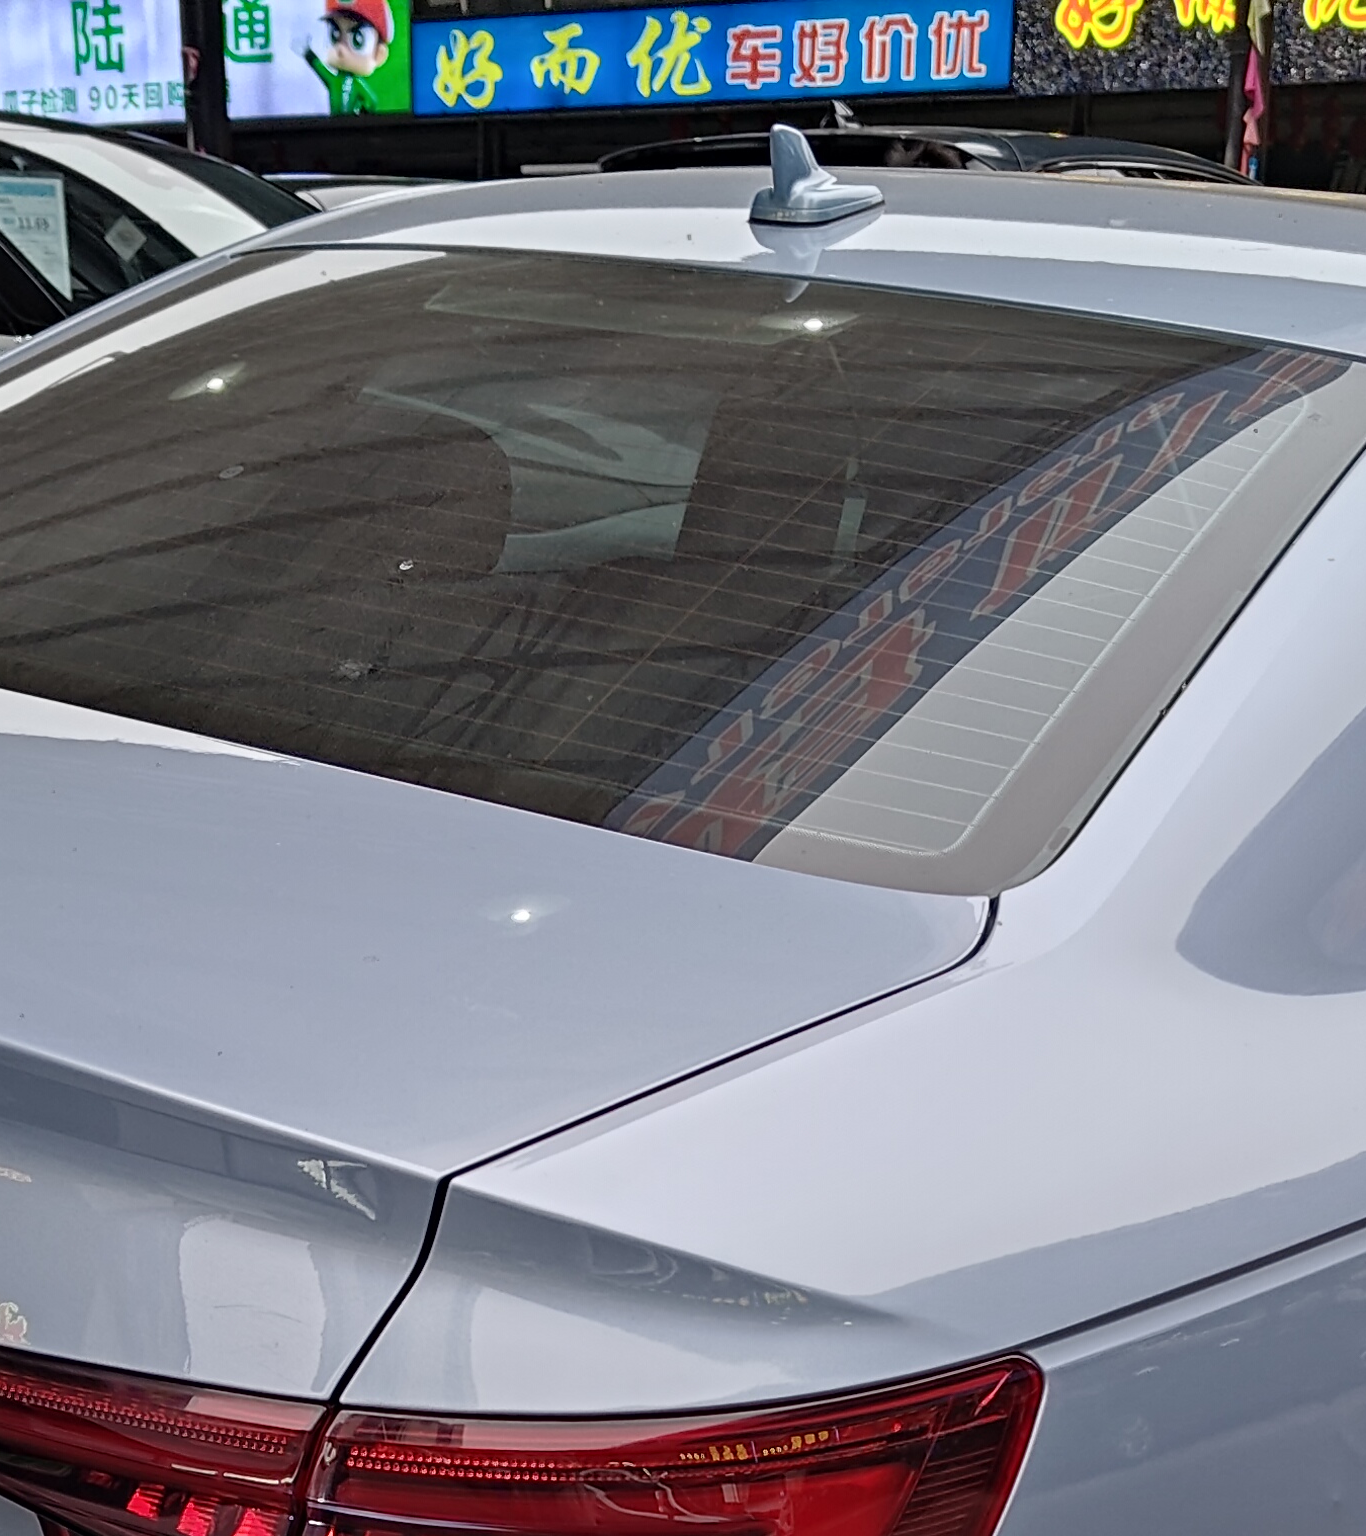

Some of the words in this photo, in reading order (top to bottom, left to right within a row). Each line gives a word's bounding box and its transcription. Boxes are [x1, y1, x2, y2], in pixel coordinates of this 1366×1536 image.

[433, 10, 712, 110] 好而优
[725, 9, 990, 91] 车好价优
